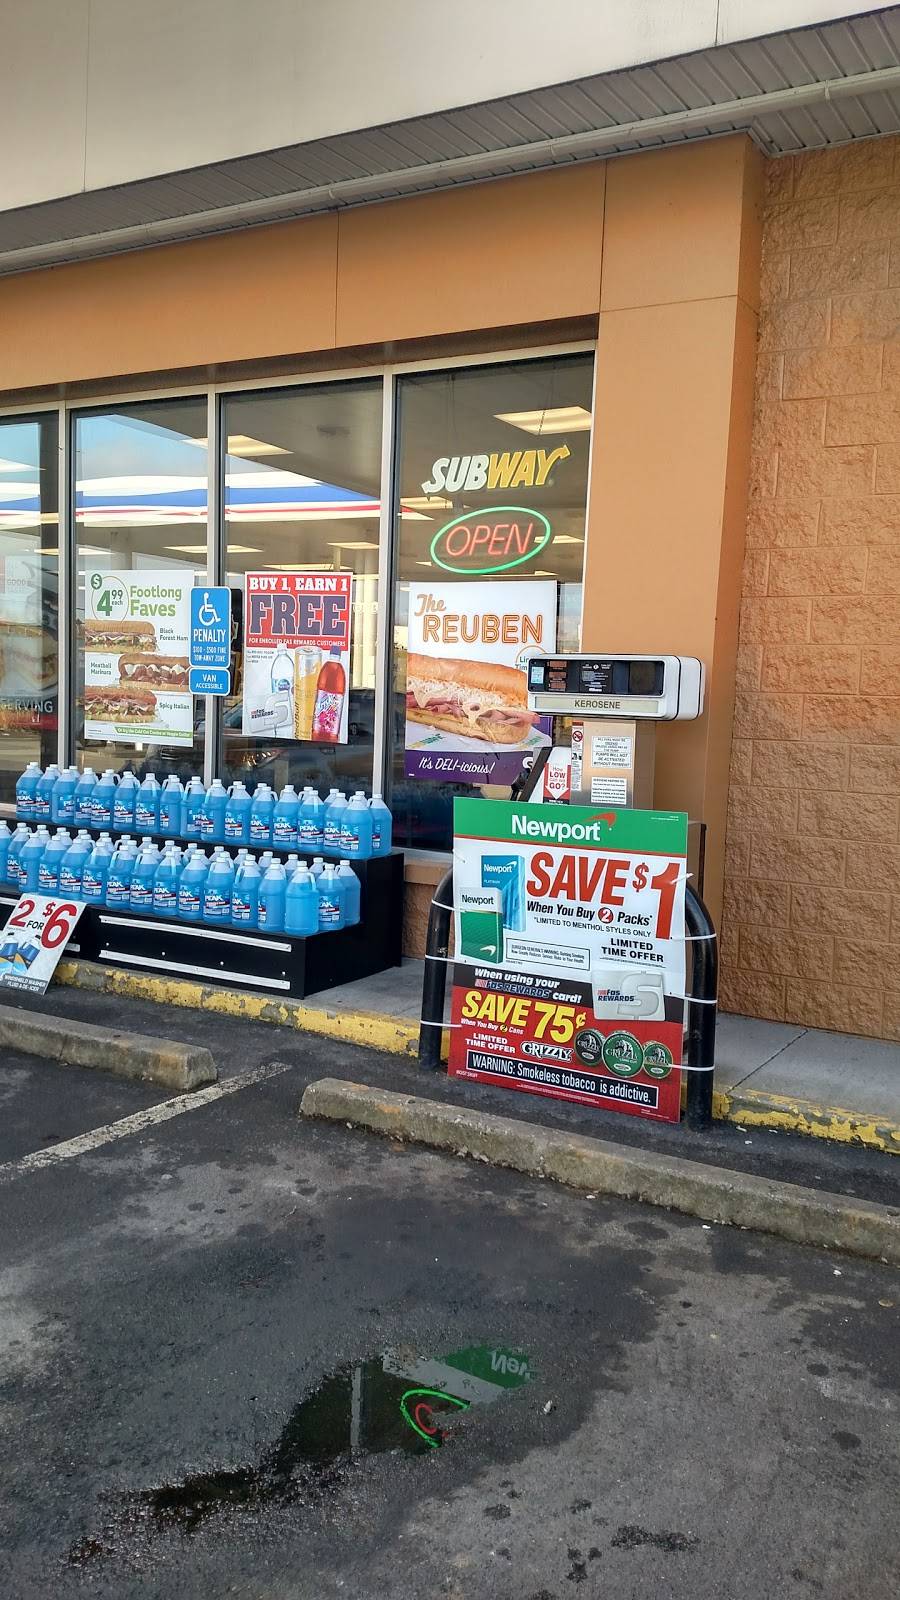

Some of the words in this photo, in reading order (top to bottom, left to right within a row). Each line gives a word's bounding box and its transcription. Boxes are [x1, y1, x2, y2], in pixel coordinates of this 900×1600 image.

[421, 445, 571, 493] SUBWAY
[445, 523, 532, 557] OPEN
[130, 584, 182, 601] Footlong
[250, 577, 279, 590] BUY
[295, 578, 338, 592] EARN
[341, 578, 348, 591] 1
[130, 599, 176, 616] Faves
[414, 594, 447, 617] The
[250, 593, 347, 638] FREE
[194, 628, 226, 642] PENALTY
[422, 614, 543, 644] REUBEN
[202, 674, 216, 682] VAN
[574, 699, 621, 710] KEROSENE
[418, 756, 434, 769] It's
[434, 758, 496, 774] DELI-icious!
[512, 814, 601, 842] Newport
[484, 864, 512, 874] Newport
[526, 851, 631, 906] SAVE
[462, 894, 494, 905] Newport
[9, 900, 35, 927] 2
[26, 920, 44, 930] FOR
[526, 900, 554, 915] When
[556, 904, 574, 918] You
[576, 904, 595, 921] Buy
[562, 919, 571, 927] TO
[572, 921, 605, 932] MENTHOL
[606, 924, 632, 935] STYLES
[632, 927, 651, 938] ONLY
[610, 937, 653, 950] LIMITED
[601, 946, 626, 957] TIME
[629, 950, 664, 963] OFFER
[475, 968, 503, 979] When
[504, 972, 535, 986] using
[536, 978, 560, 989] your
[552, 991, 582, 1004] card!
[461, 990, 532, 1027] SAVE
[460, 1018, 476, 1026] When
[476, 1020, 487, 1028] You
[488, 1022, 499, 1032] Buy
[508, 1026, 524, 1035] Cans
[465, 1038, 485, 1048] TIME
[486, 1042, 516, 1053] OFFER
[473, 1033, 508, 1044] LIMITED
[520, 1040, 574, 1062] GRIZZLY
[472, 1054, 516, 1076] WARNING:
[517, 1062, 560, 1084] Smokeless
[562, 1071, 596, 1091] tobacco
[599, 1079, 607, 1092] is
[609, 1082, 651, 1103] addictive.
